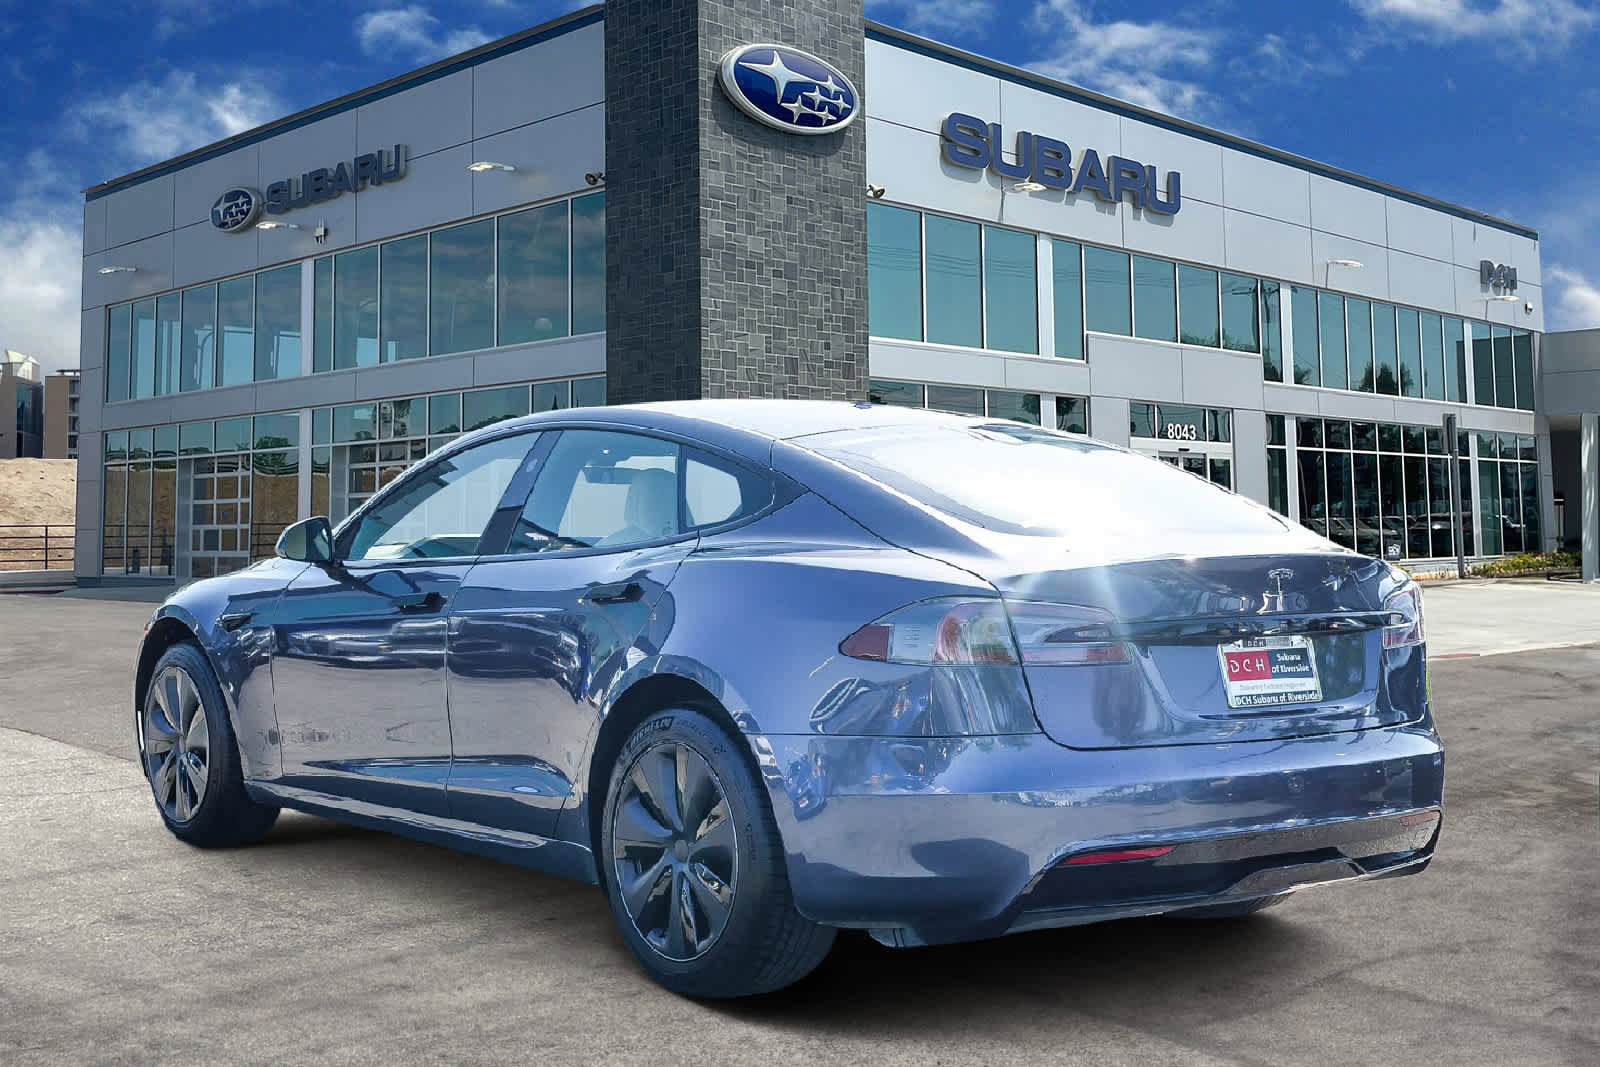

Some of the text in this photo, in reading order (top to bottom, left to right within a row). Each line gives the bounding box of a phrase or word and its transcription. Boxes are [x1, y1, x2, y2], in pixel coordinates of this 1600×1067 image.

[942, 112, 1181, 215] SUBARU
[266, 144, 406, 215] SUBARU
[1167, 423, 1197, 440] 8043
[1276, 652, 1301, 662] Subaru
[1228, 658, 1266, 673] DCH
[1271, 663, 1310, 673] of Riverside
[1235, 695, 1252, 706] DCH
[1253, 694, 1278, 705] Subaru
[1279, 694, 1287, 703] of
